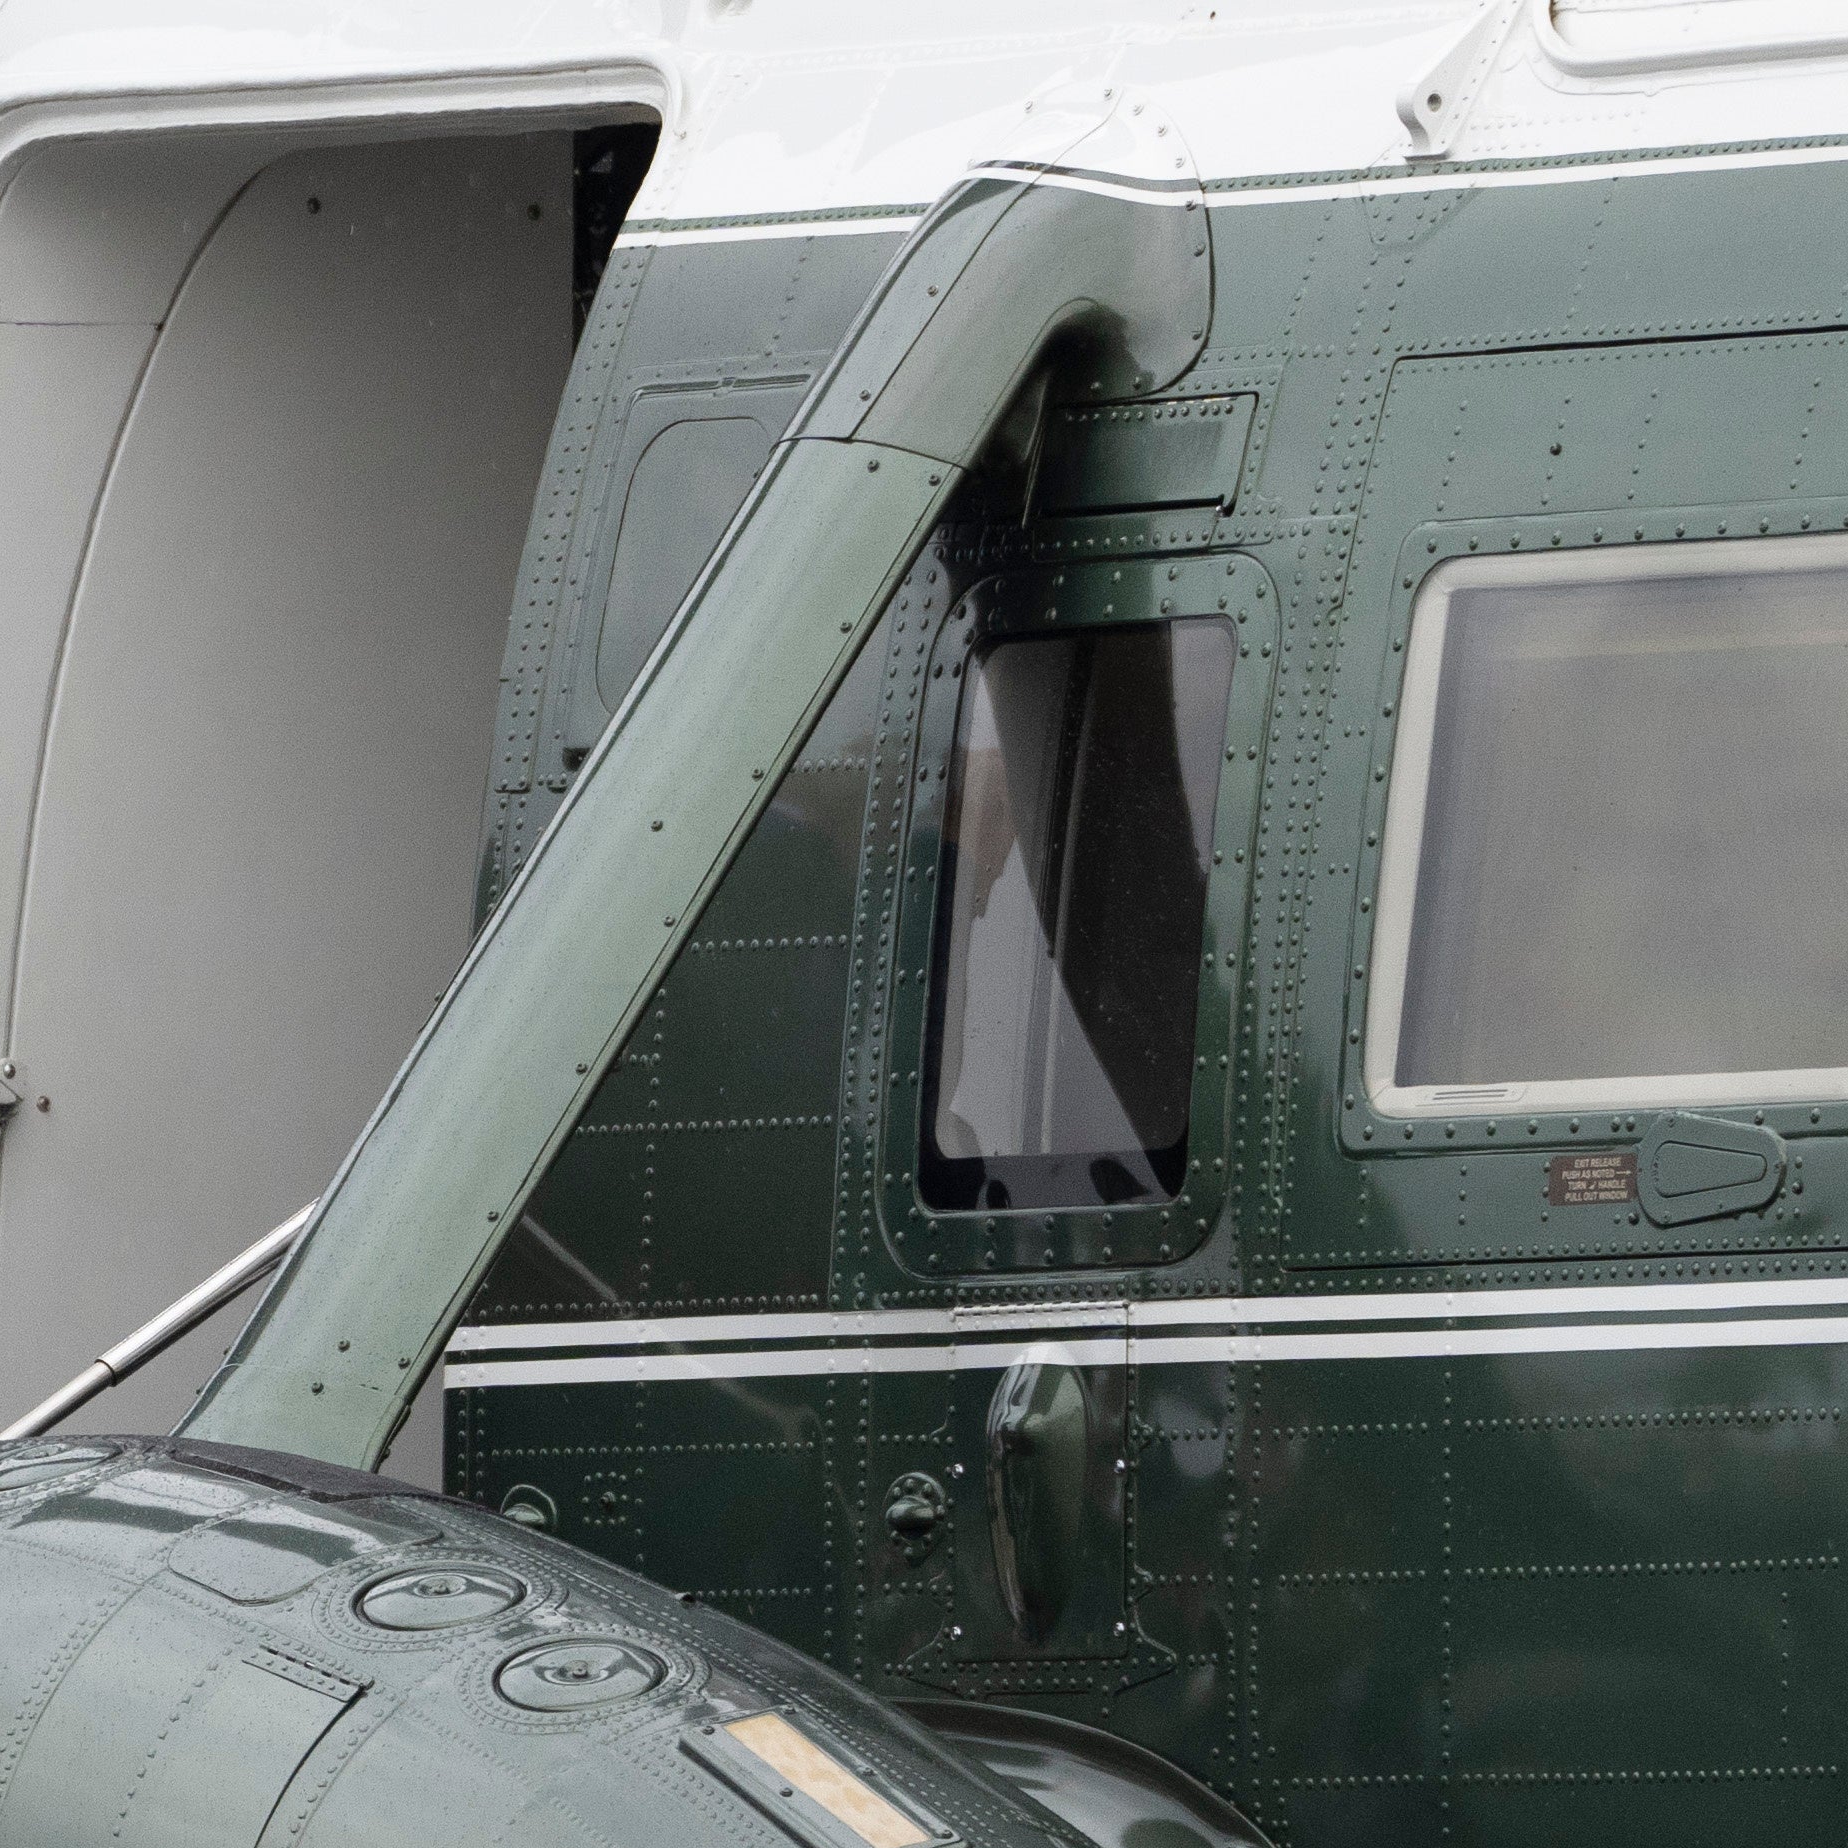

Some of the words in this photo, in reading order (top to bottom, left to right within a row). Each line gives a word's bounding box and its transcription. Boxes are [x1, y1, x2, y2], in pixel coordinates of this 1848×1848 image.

[1574, 1158, 1589, 1168] EXIT
[1590, 1157, 1622, 1168] RELEASE
[1562, 1170, 1581, 1180] PUSH
[1581, 1169, 1591, 1179] AS
[1591, 1168, 1615, 1178] NOTED
[1567, 1181, 1587, 1190] TURN
[1597, 1179, 1626, 1189] HANDLE
[1564, 1192, 1583, 1202] PULL
[1583, 1191, 1598, 1201] OUT
[1598, 1190, 1628, 1200] WINDOW
